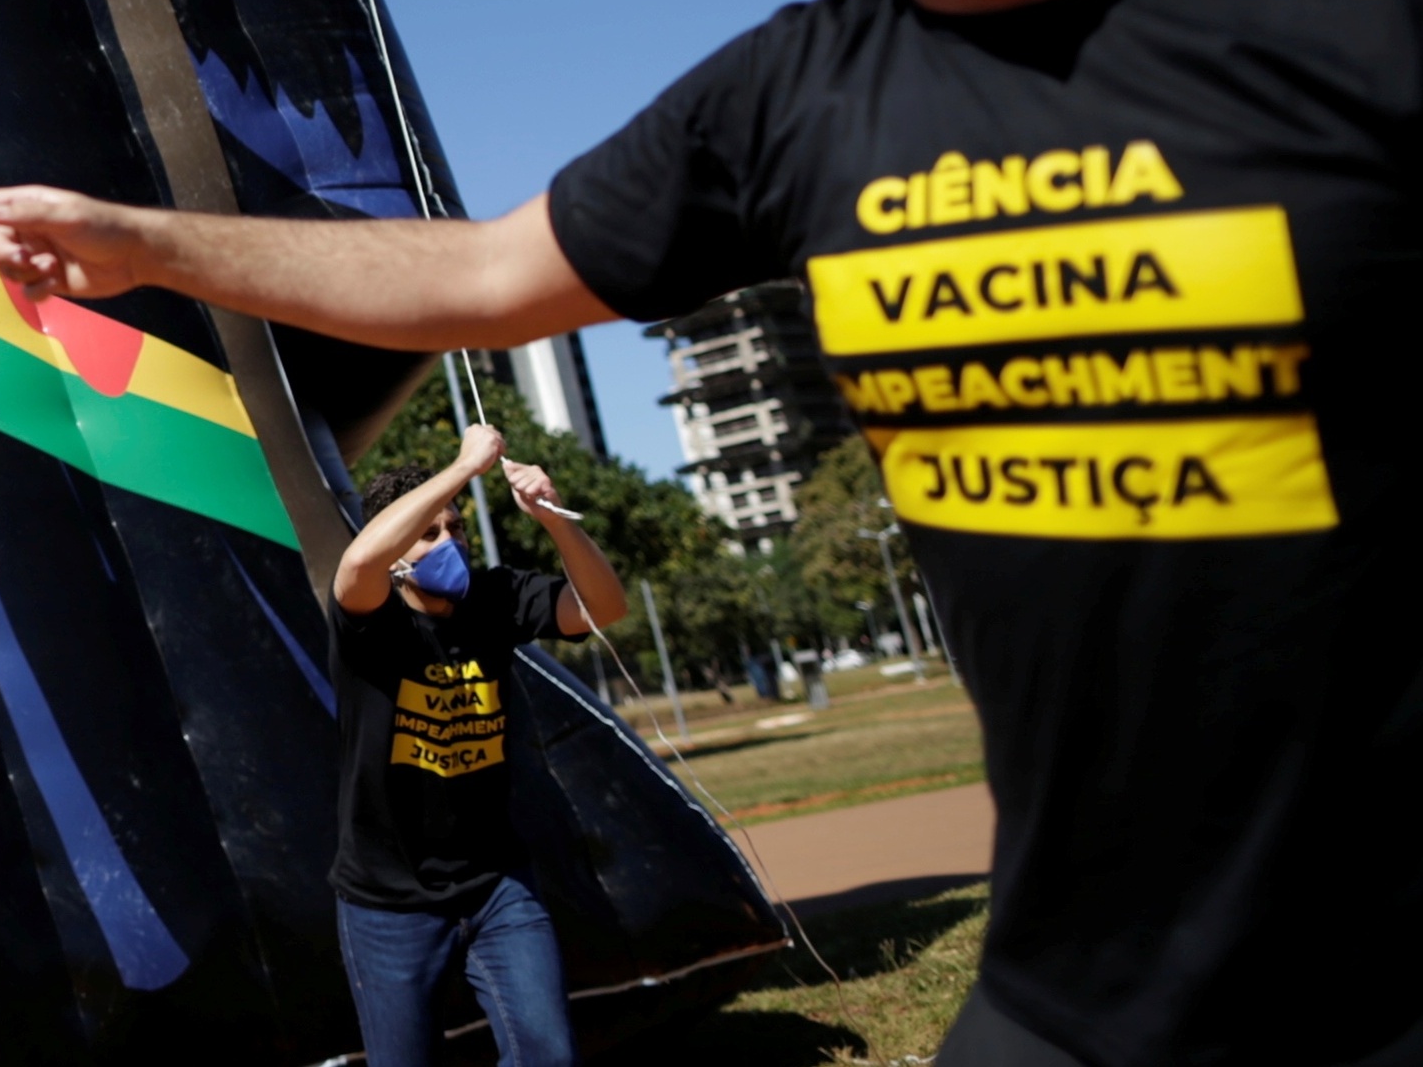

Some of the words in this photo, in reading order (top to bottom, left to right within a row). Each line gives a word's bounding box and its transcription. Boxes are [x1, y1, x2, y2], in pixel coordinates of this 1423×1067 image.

[856, 140, 1183, 234] CIÊNCIA
[869, 252, 1181, 323] VACINA
[834, 341, 1309, 414] MPEACHMENT
[917, 454, 1232, 526] JUSTIÇA
[395, 713, 506, 741] IMPEAHMENT
